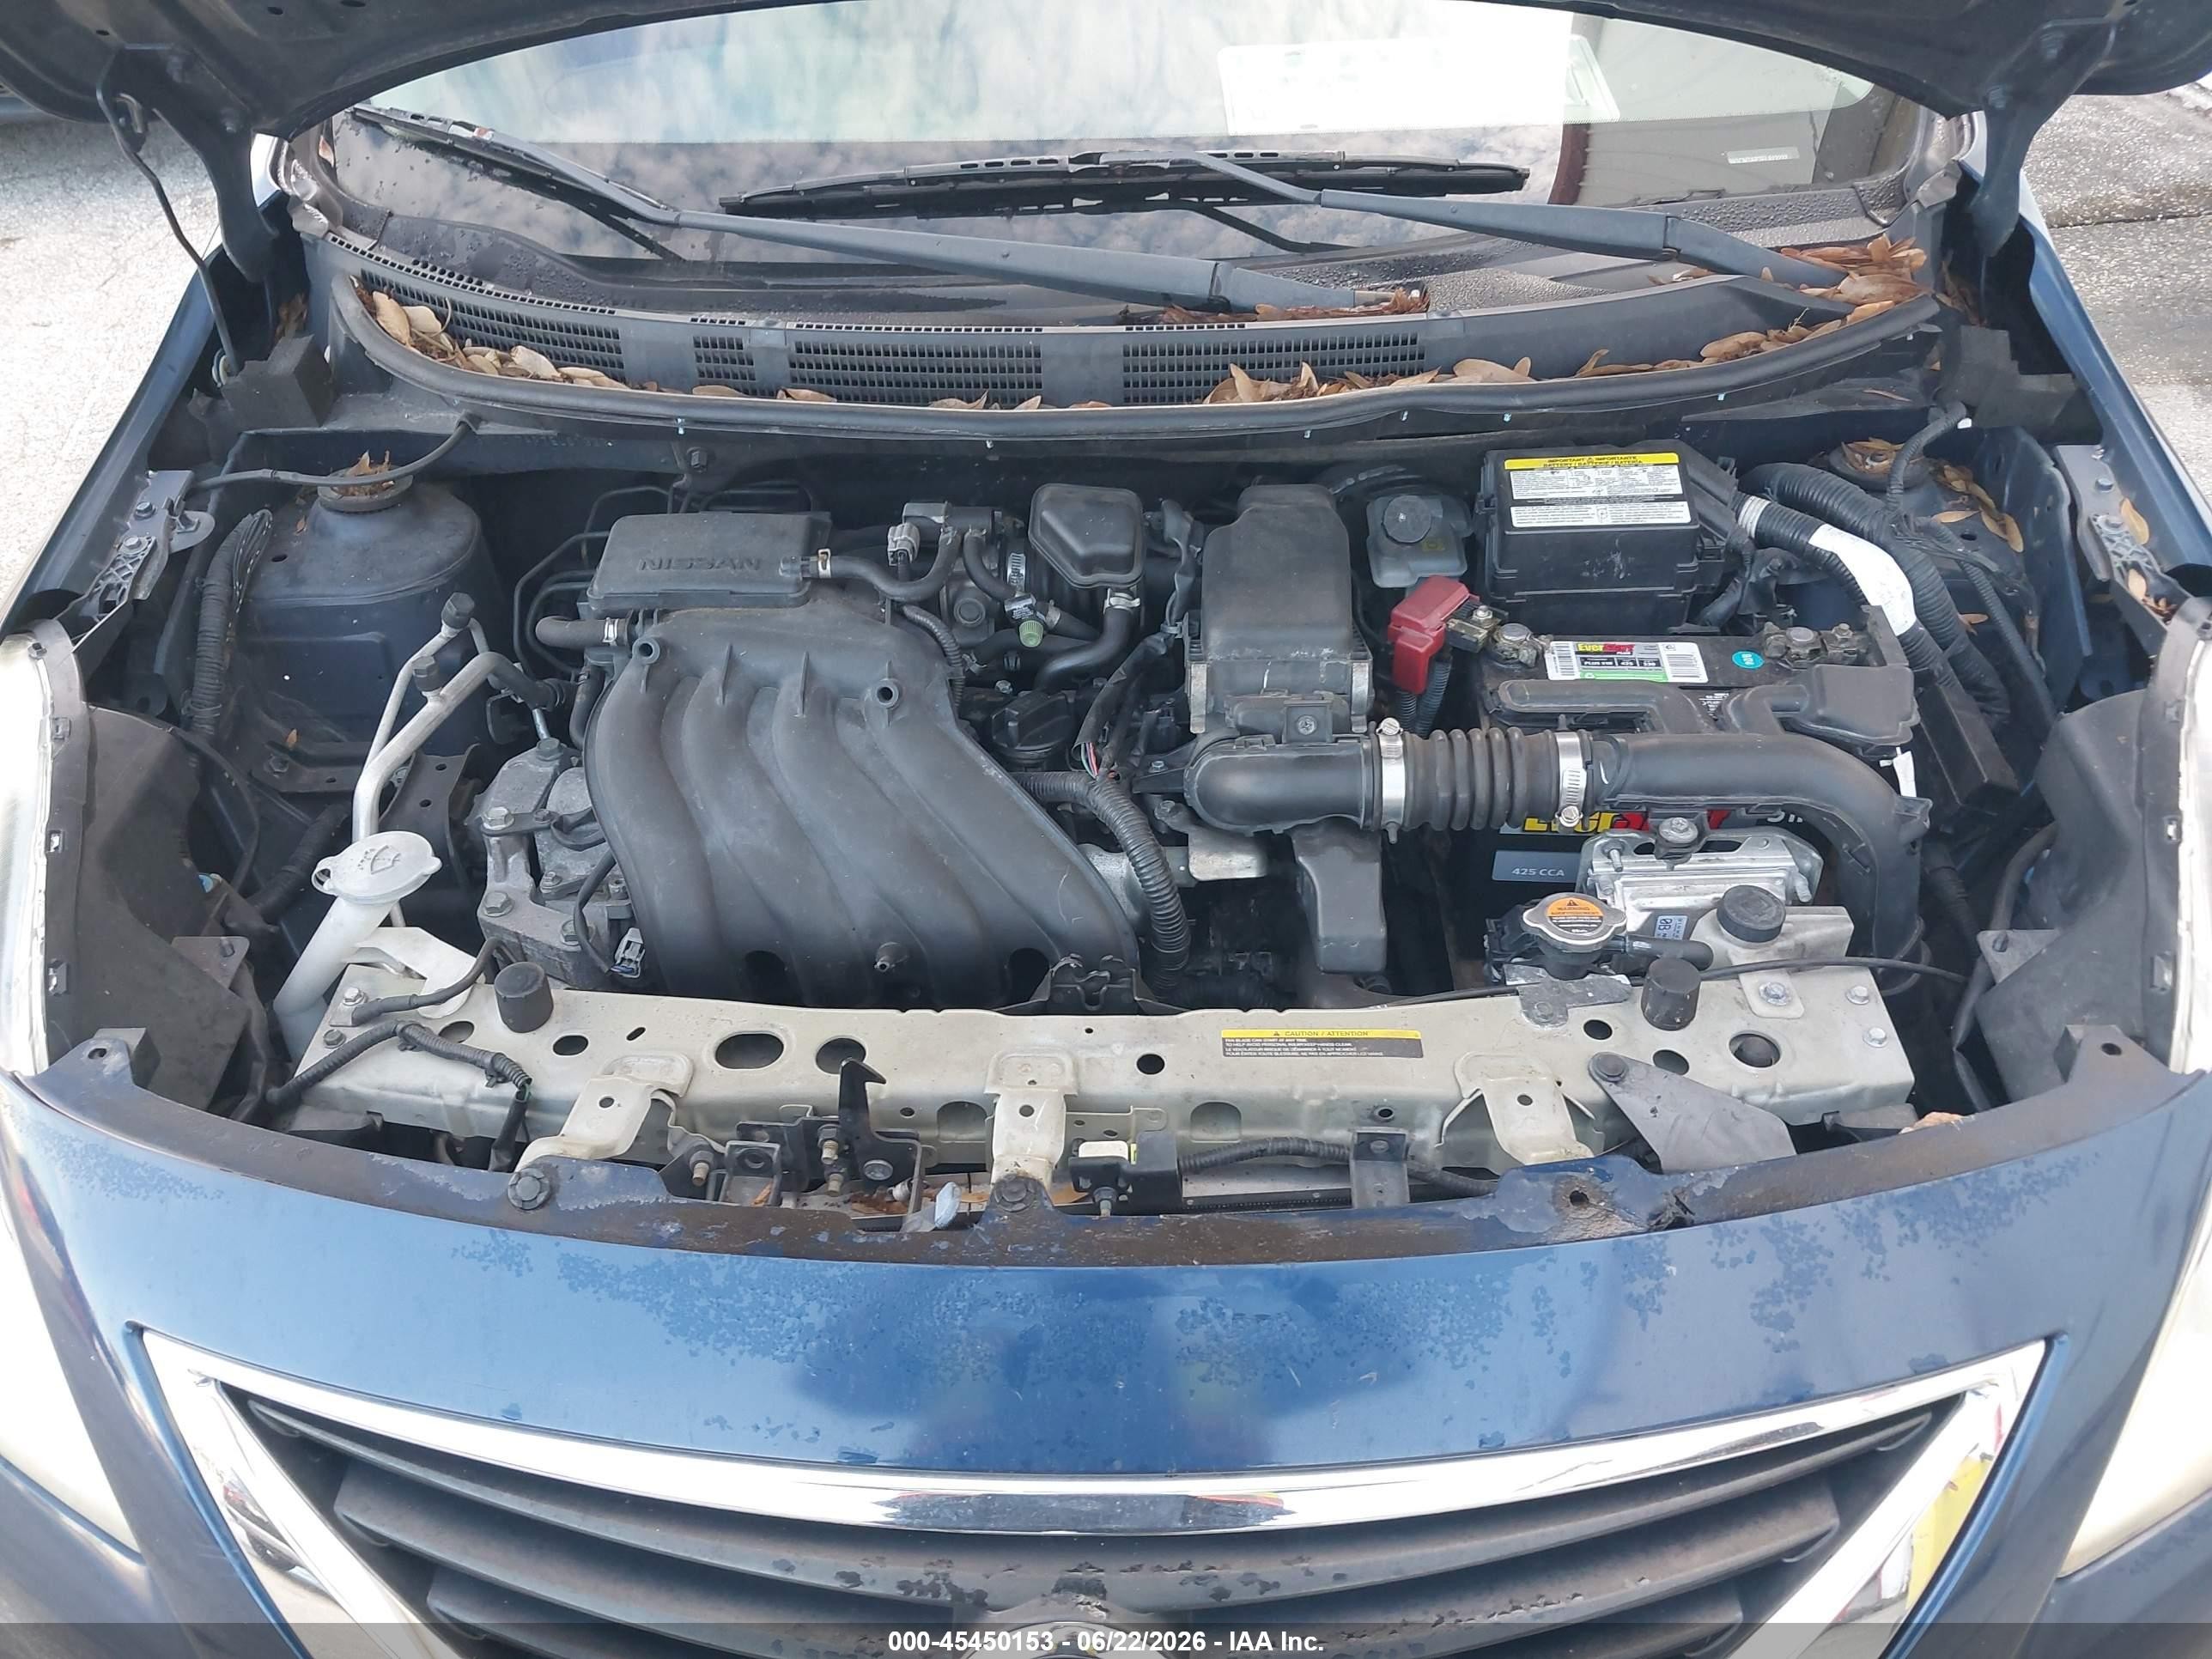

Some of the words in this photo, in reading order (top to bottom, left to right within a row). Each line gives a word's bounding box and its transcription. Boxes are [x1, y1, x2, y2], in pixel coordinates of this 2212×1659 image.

[638, 556, 763, 572] NISSAN
[1511, 867, 1537, 876] 425
[1540, 867, 1565, 877] CCA
